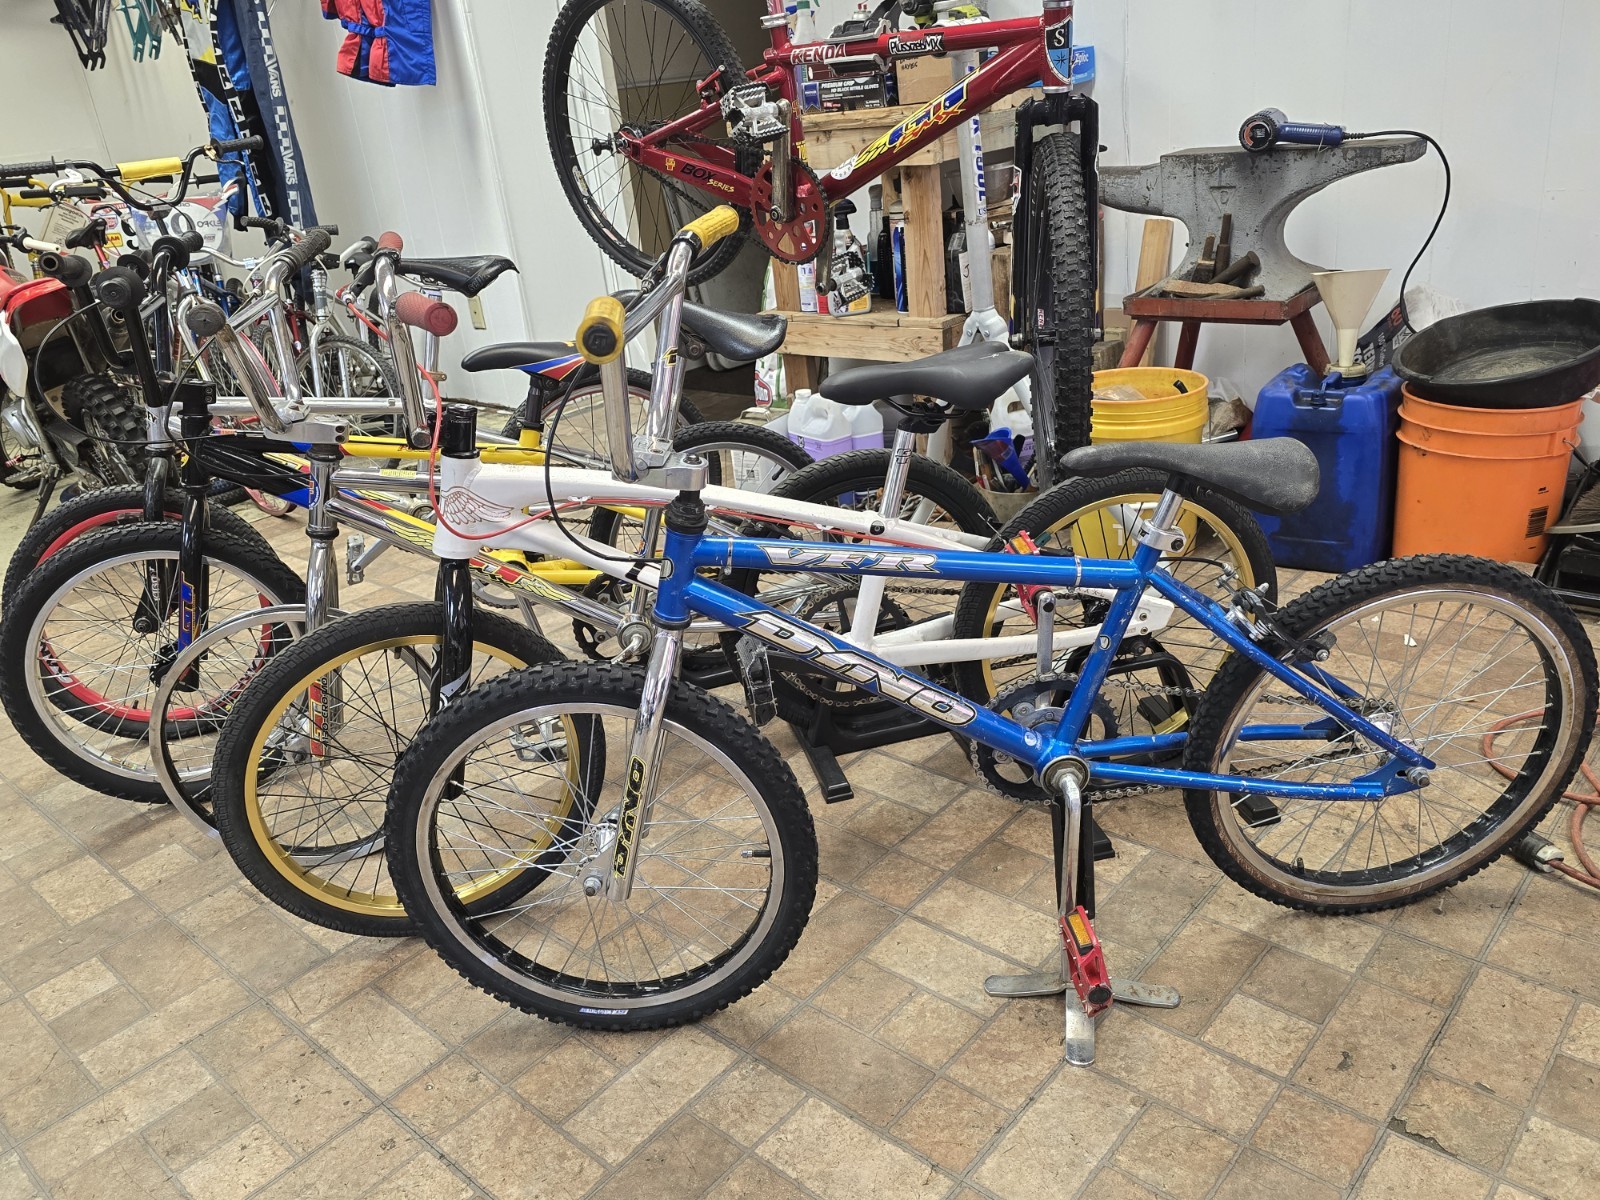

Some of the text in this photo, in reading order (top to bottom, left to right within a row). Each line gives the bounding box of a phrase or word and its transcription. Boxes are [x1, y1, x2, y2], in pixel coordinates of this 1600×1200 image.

[1053, 28, 1065, 47] S
[790, 43, 847, 65] KENDA
[267, 60, 282, 98] VANS
[283, 151, 299, 186] VANS
[680, 162, 717, 182] BOX
[706, 178, 735, 193] SERIES
[757, 544, 941, 574] VFR
[734, 610, 977, 726] DYNO
[613, 754, 647, 879] DYNO
